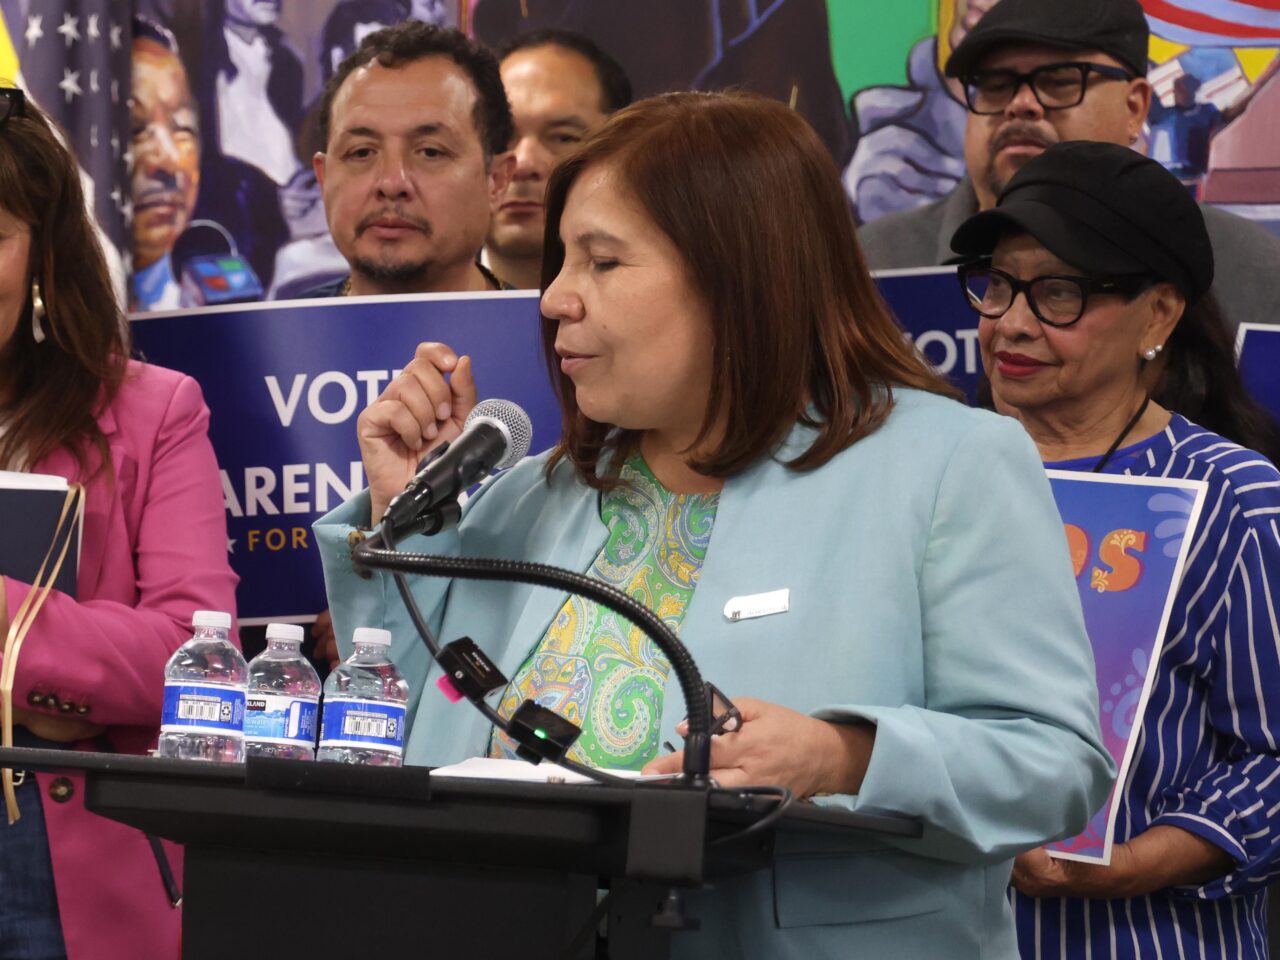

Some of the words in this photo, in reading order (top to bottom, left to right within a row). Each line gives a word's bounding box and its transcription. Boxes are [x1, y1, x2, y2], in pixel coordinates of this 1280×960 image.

[902, 329, 980, 374] OT
[264, 369, 404, 427] VOT
[220, 461, 363, 517] AREN
[247, 527, 309, 551] FOR
